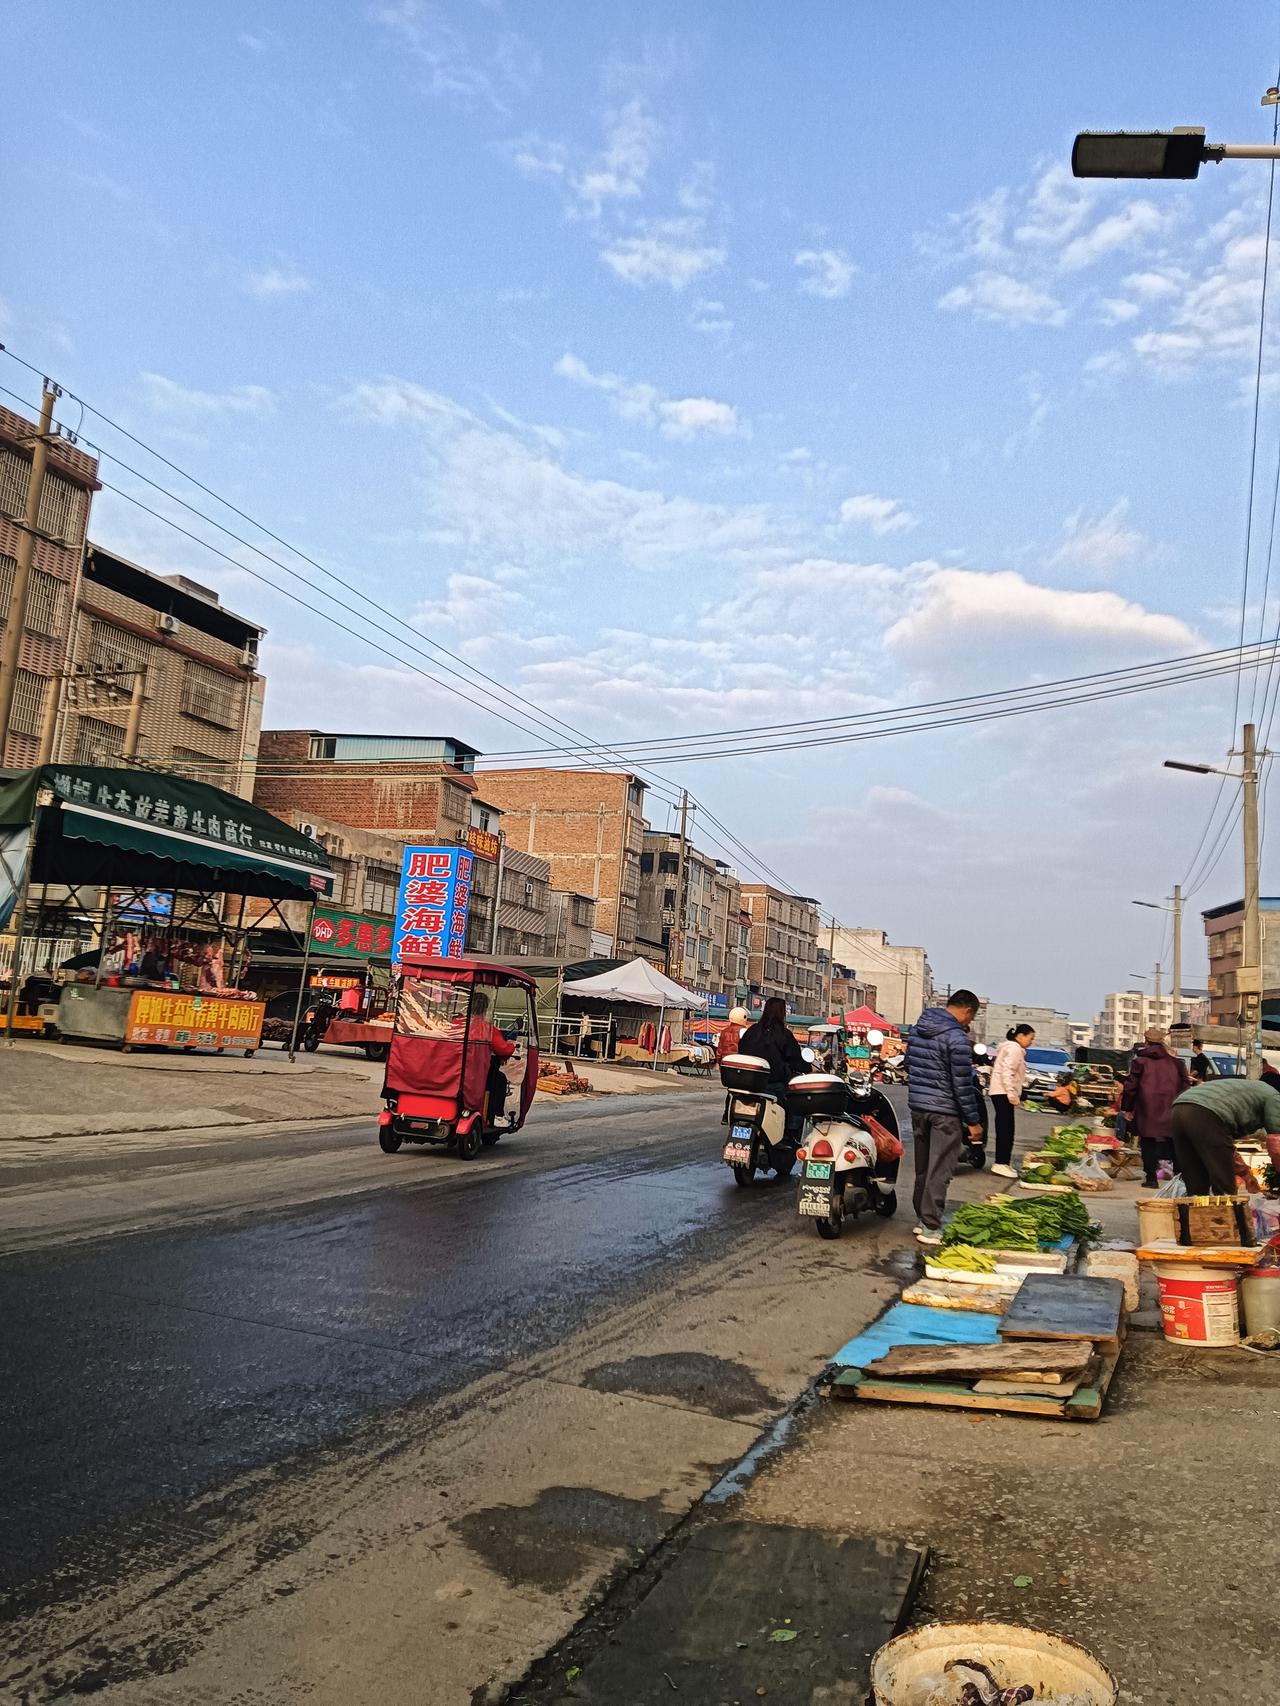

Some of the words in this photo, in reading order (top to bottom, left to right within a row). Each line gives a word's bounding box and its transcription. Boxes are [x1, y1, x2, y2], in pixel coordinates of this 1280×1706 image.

[313, 925, 334, 939] DHD
[397, 853, 451, 957] 肥婆海鲜
[447, 856, 472, 960] 肥婆海鲜
